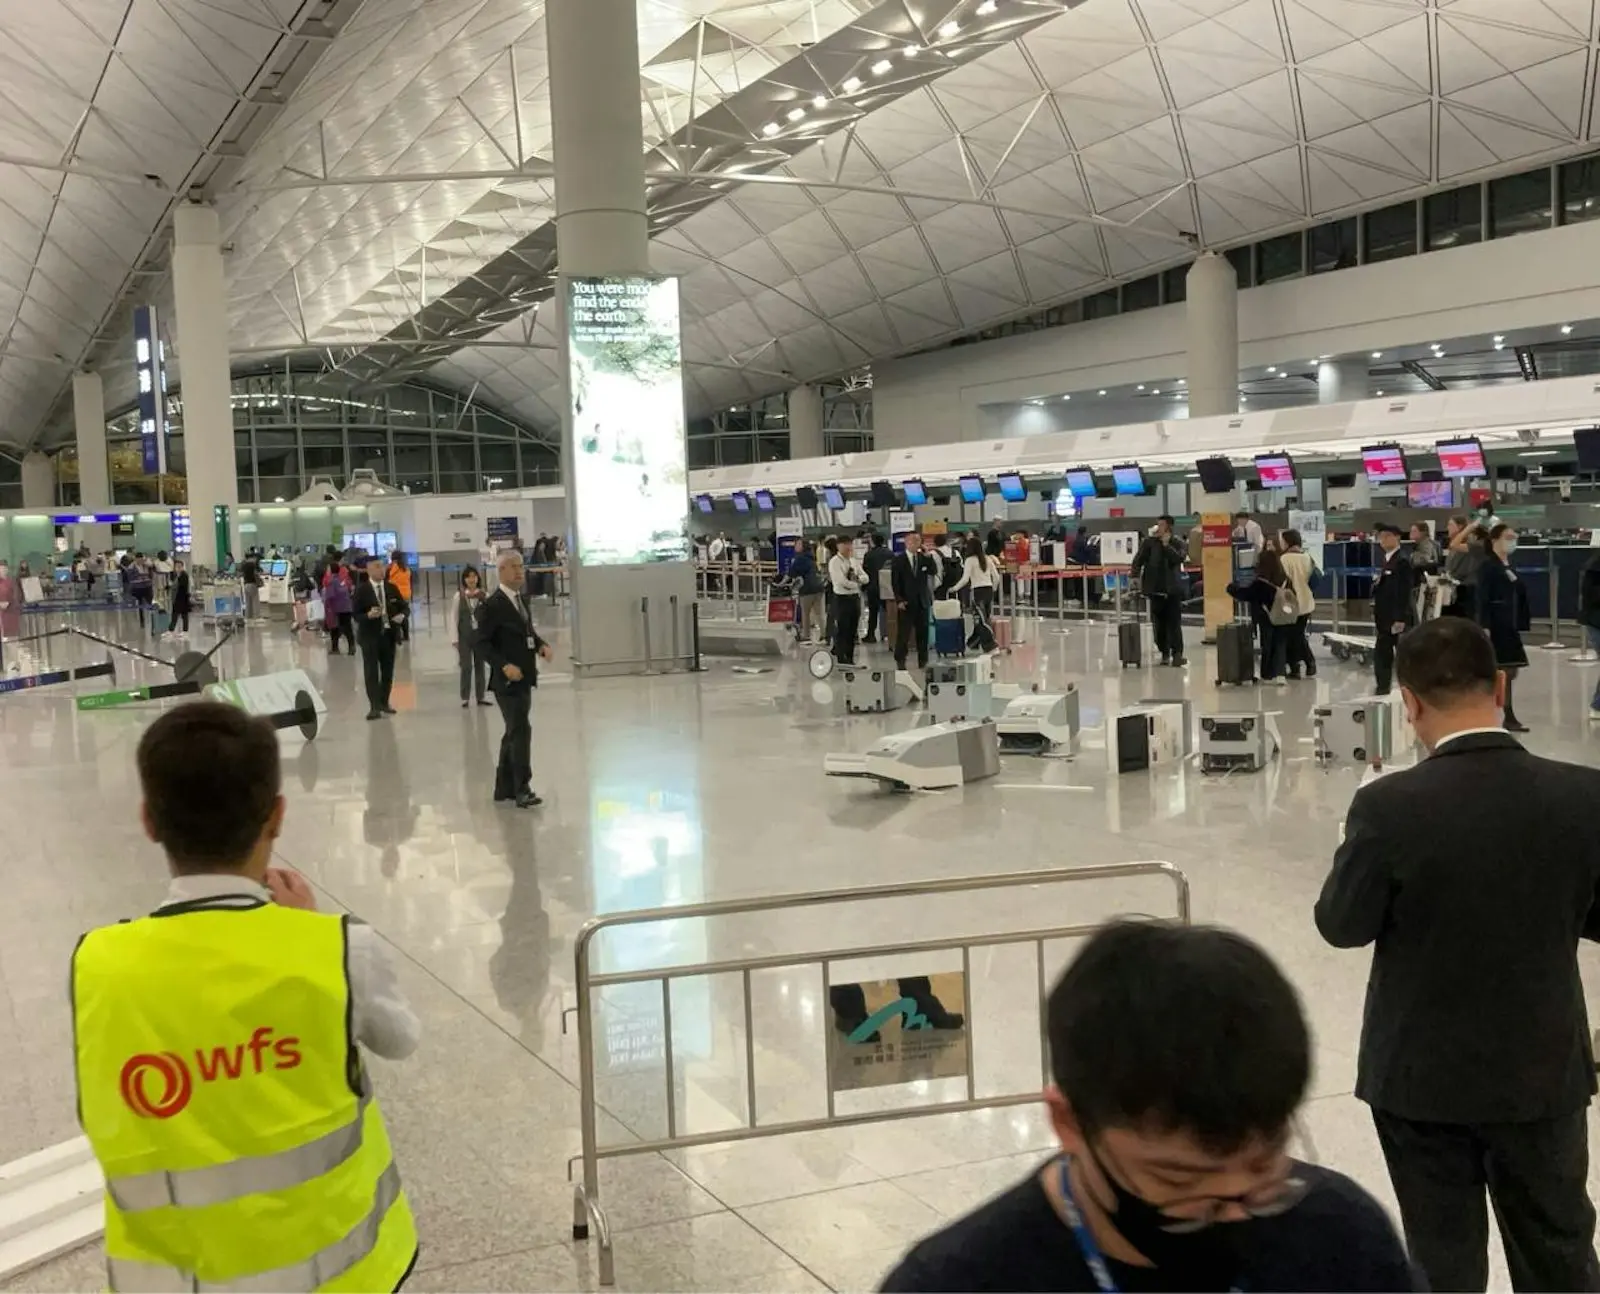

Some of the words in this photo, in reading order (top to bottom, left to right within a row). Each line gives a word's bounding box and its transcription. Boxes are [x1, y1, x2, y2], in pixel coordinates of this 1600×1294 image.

[572, 281, 595, 294] You
[597, 284, 625, 295] were
[573, 295, 597, 308] find
[598, 296, 617, 309] the
[574, 309, 593, 321] the
[594, 310, 626, 322] earth
[194, 1027, 302, 1081] wfs
